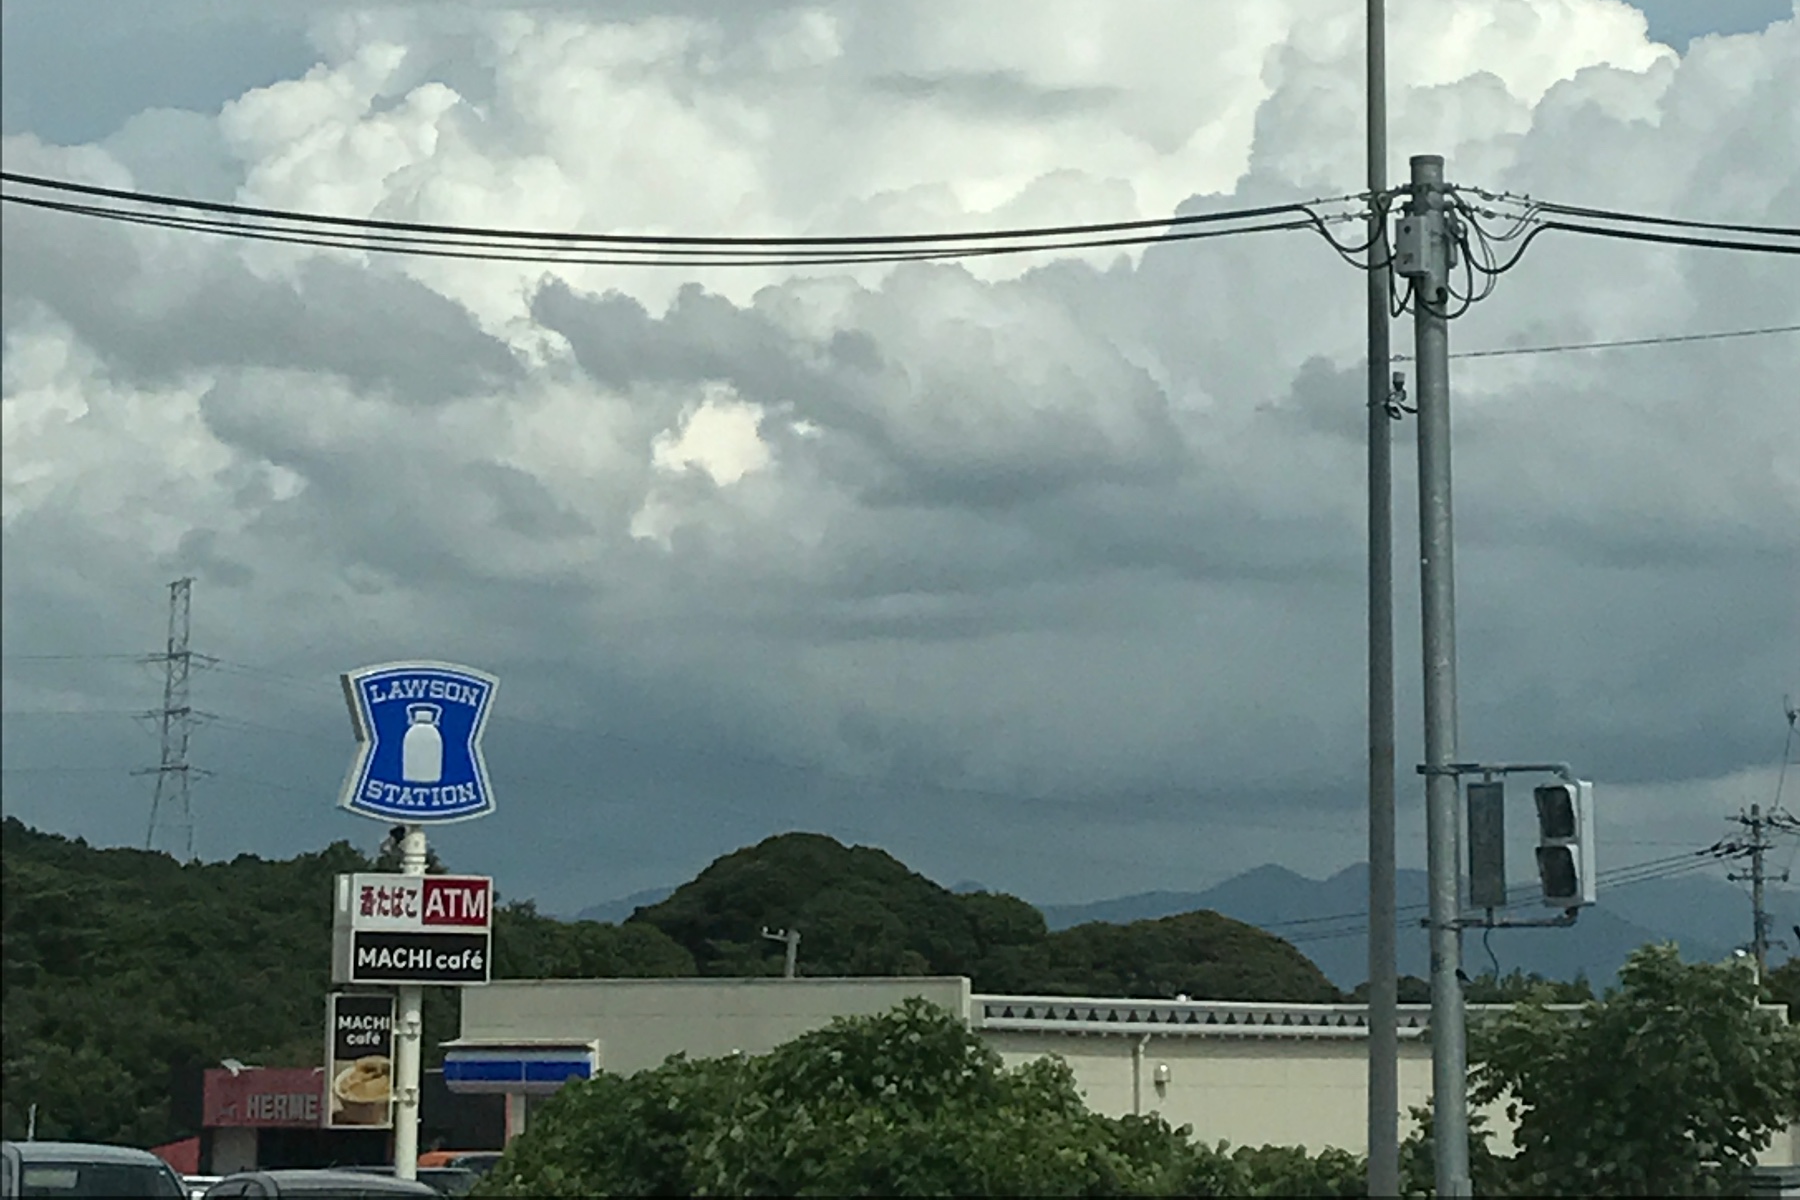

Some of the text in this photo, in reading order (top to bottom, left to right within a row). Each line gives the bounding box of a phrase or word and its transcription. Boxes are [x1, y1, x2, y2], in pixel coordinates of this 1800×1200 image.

[370, 679, 480, 707] LAWSON
[365, 779, 477, 807] STATION
[425, 888, 486, 918] ATM
[358, 947, 483, 970] MACHI café
[338, 1015, 390, 1030] MACHI
[346, 1031, 381, 1045] café
